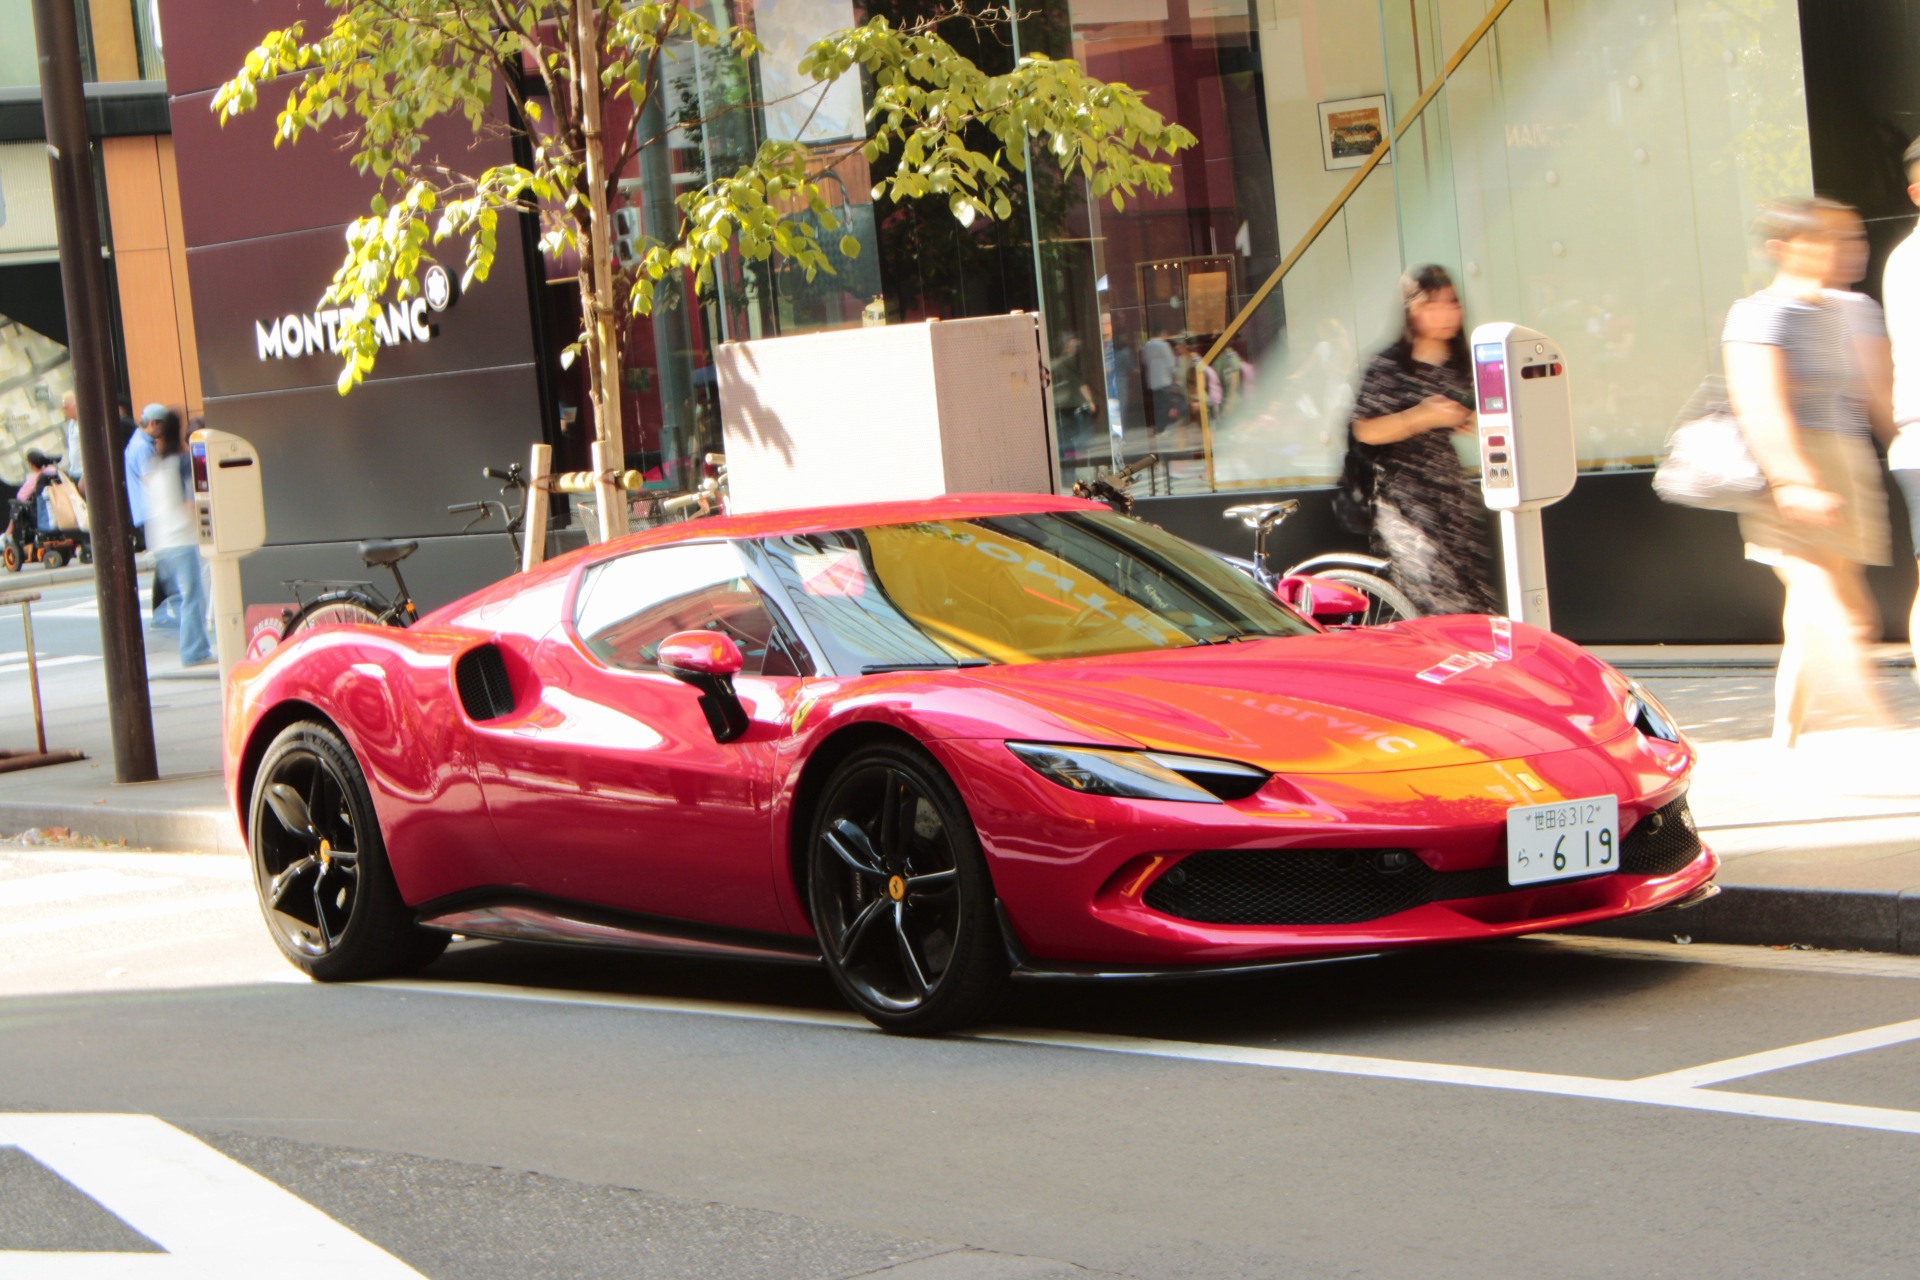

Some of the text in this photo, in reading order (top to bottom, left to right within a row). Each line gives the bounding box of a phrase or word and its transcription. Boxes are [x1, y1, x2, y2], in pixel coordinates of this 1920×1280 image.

[255, 297, 431, 362] MONTANC
[1534, 804, 1595, 831] 世田谷312
